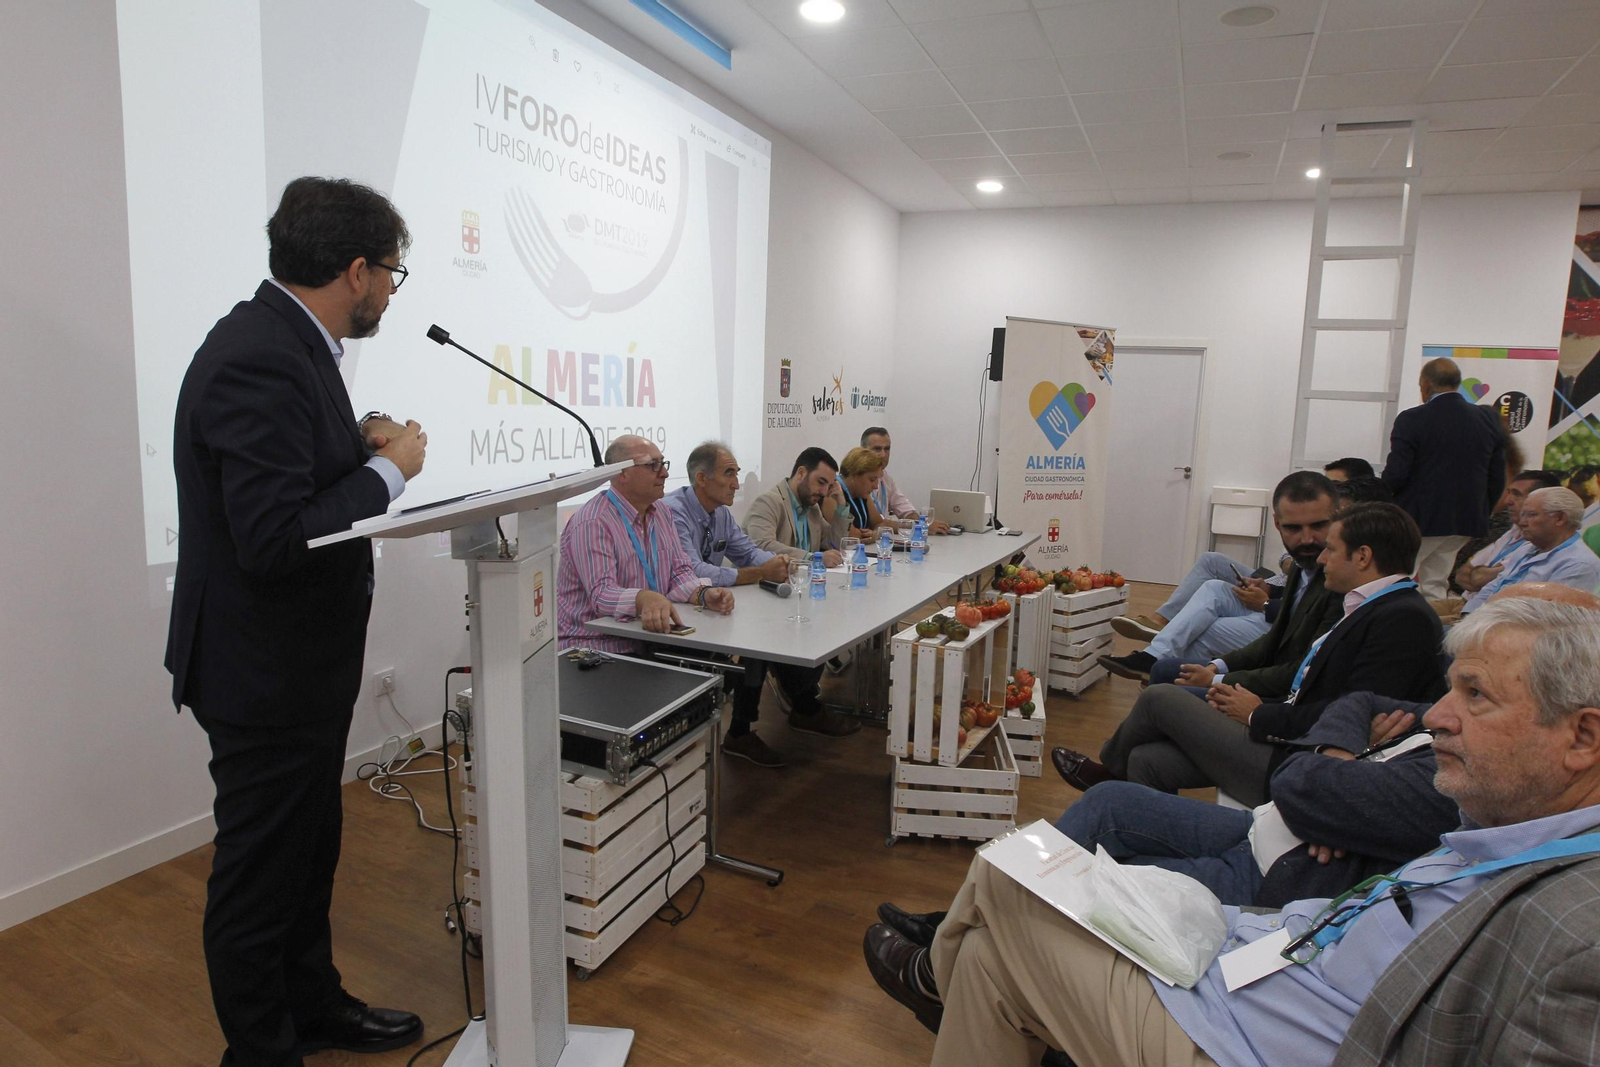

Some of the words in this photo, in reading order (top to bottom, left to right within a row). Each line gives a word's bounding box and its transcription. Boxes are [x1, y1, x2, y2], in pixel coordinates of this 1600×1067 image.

[473, 122, 554, 173] TURISMO
[568, 161, 667, 214] GASTRONOMÍA
[452, 255, 488, 273] ALMERÍA
[487, 341, 656, 408] ALMERÍA
[767, 401, 803, 414] DIPUTACIÓN
[861, 390, 887, 411] cajamar
[767, 417, 776, 428] DE
[777, 415, 802, 428] ALMERÍA
[470, 420, 525, 466] MÁS
[1026, 453, 1086, 470] ALMERÍA
[1045, 490, 1083, 500] comérsela!
[1038, 544, 1069, 554] ALMERÍA
